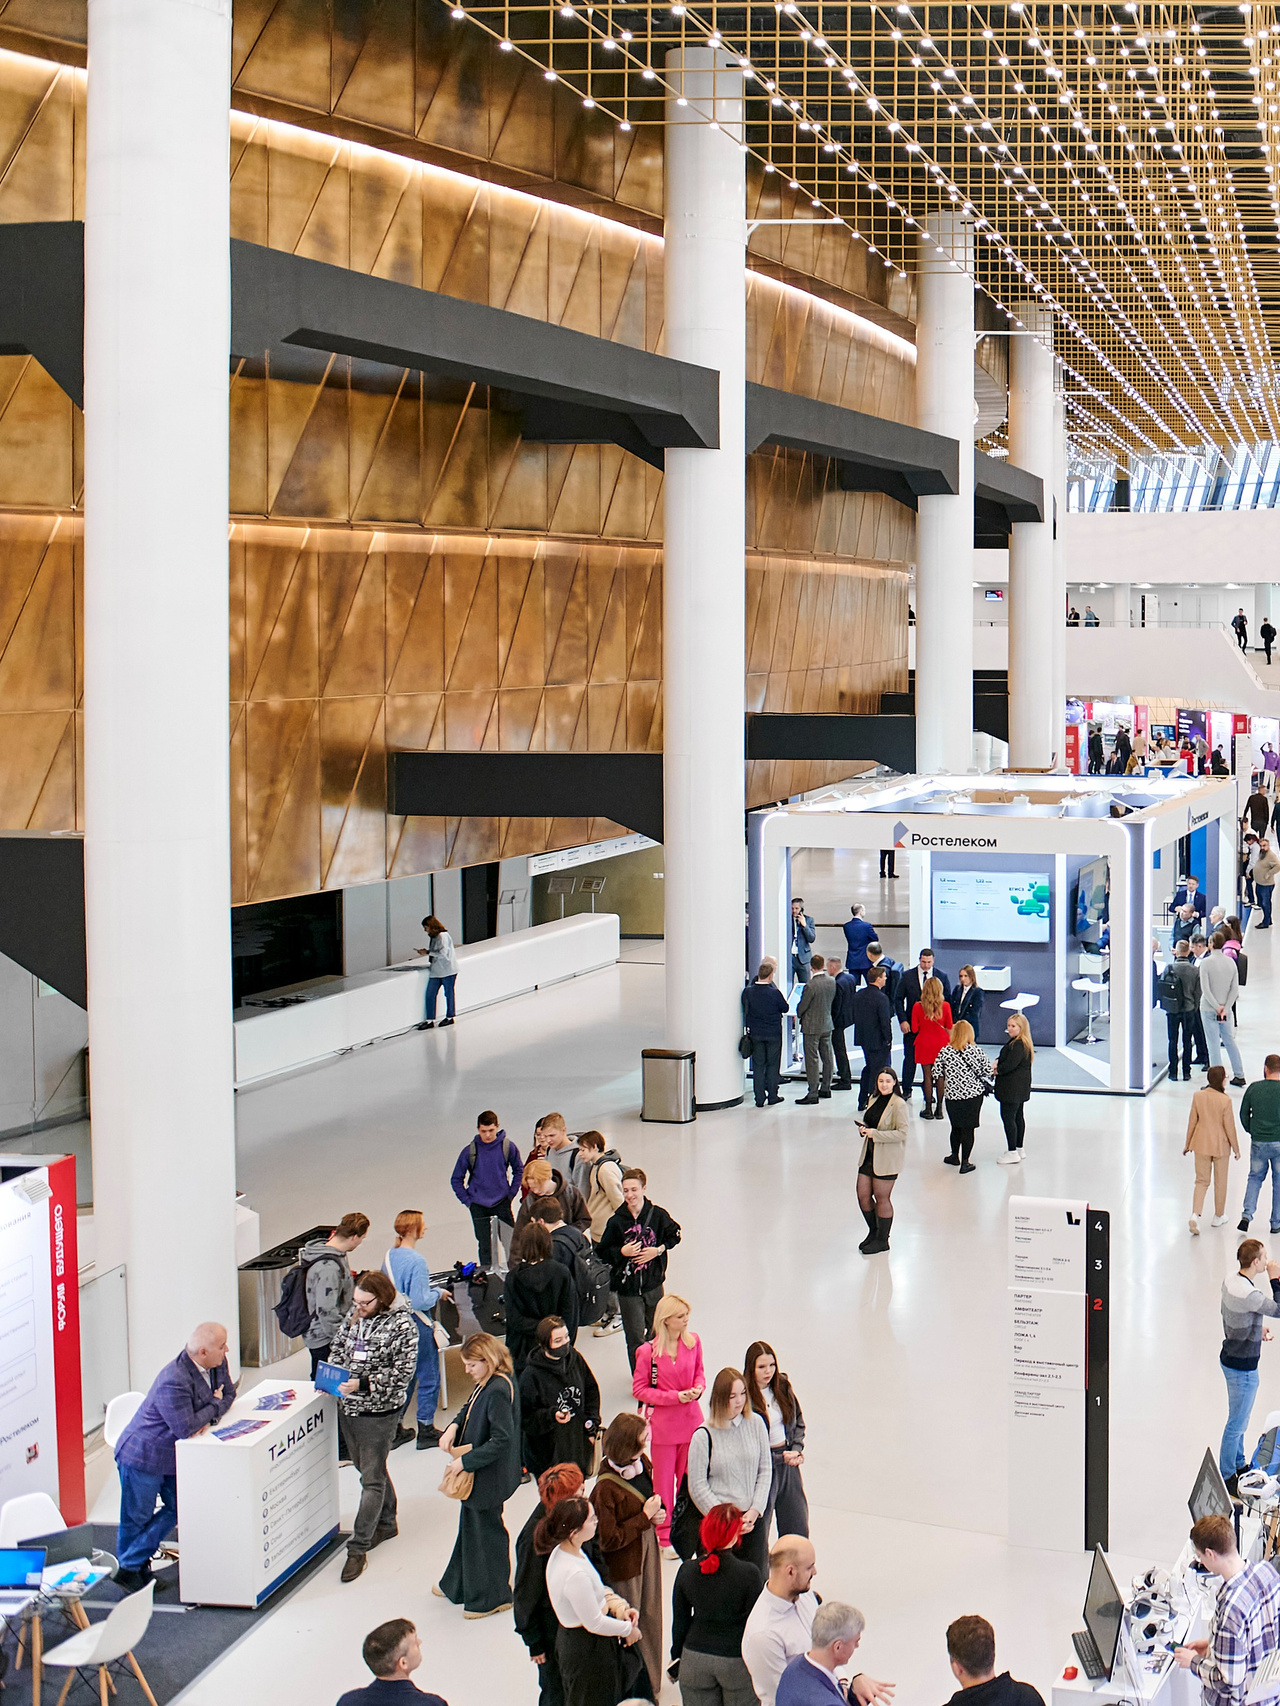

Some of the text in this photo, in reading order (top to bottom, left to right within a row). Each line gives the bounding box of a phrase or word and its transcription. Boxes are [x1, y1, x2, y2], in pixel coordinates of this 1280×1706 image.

[912, 834, 997, 848] Ростелеком
[1094, 1221, 1103, 1231] 4
[1094, 1260, 1102, 1270] 3
[57, 1282, 66, 1331] ФОРУМ
[1093, 1298, 1102, 1310] 2
[1096, 1396, 1101, 1406] 1
